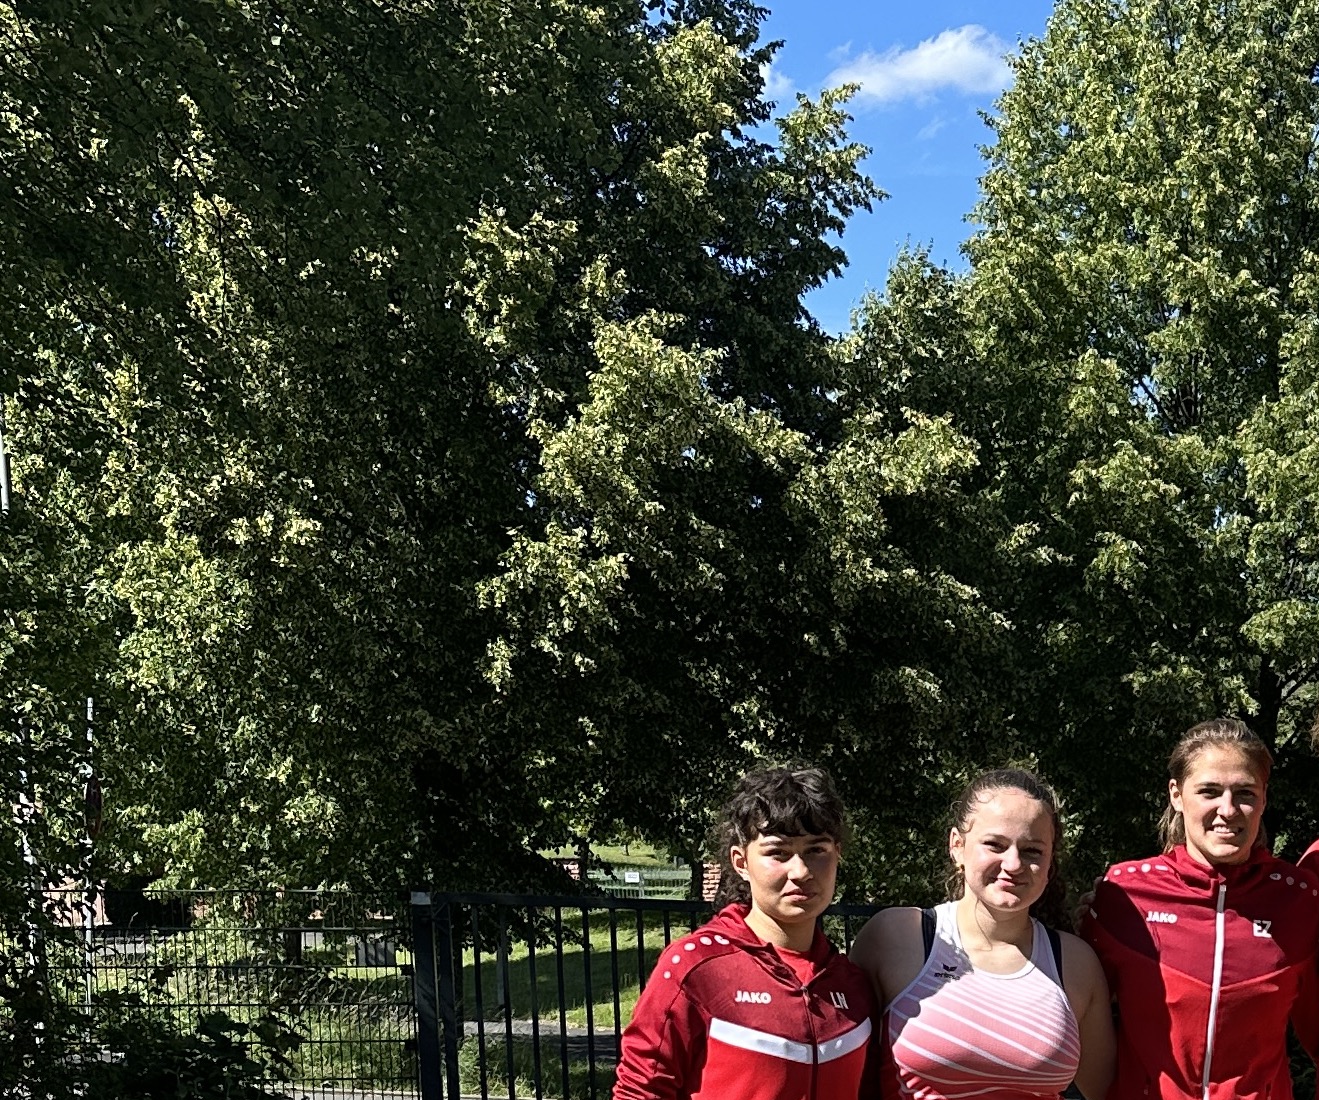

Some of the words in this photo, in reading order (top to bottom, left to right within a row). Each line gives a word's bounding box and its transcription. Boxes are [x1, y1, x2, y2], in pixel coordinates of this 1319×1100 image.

[1146, 911, 1178, 924] JAKO
[1253, 919, 1272, 938] EZ
[735, 990, 772, 1004] JAKO
[830, 991, 849, 1009] LN
